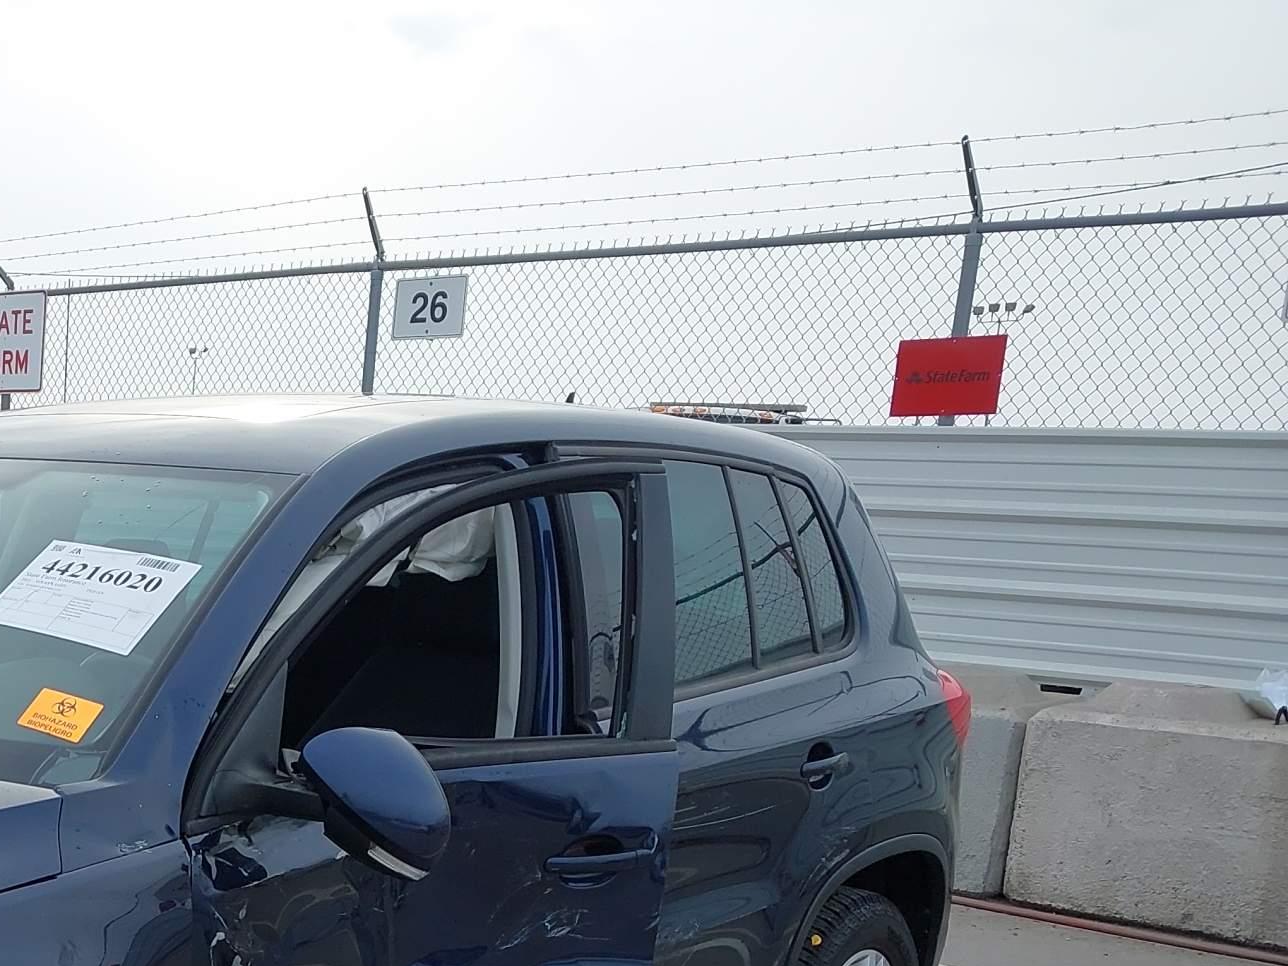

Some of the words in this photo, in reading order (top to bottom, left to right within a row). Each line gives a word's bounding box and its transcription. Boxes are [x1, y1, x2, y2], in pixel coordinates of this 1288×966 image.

[409, 290, 448, 324] 26
[41, 559, 164, 593] 44216020
[26, 719, 73, 738] BIOPELIGRO
[32, 712, 78, 731] BIOHAZARD
